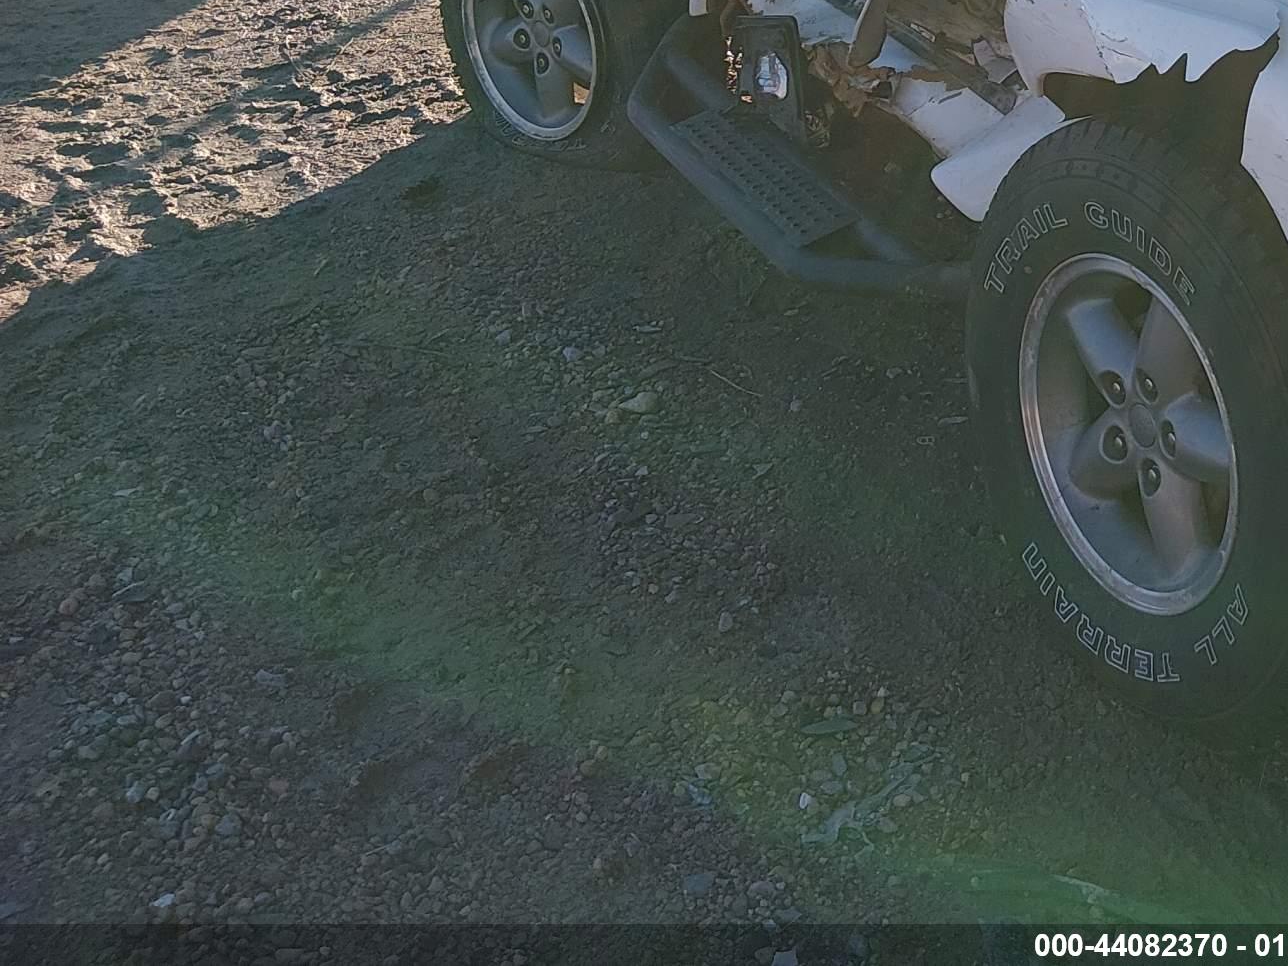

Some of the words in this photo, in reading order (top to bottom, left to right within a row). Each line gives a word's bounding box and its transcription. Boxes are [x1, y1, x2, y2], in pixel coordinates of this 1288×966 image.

[984, 203, 1069, 294] TRAIL
[1083, 201, 1196, 307] GUIDE
[1022, 541, 1181, 683] TERRAIN
[1194, 583, 1249, 666] ALL
